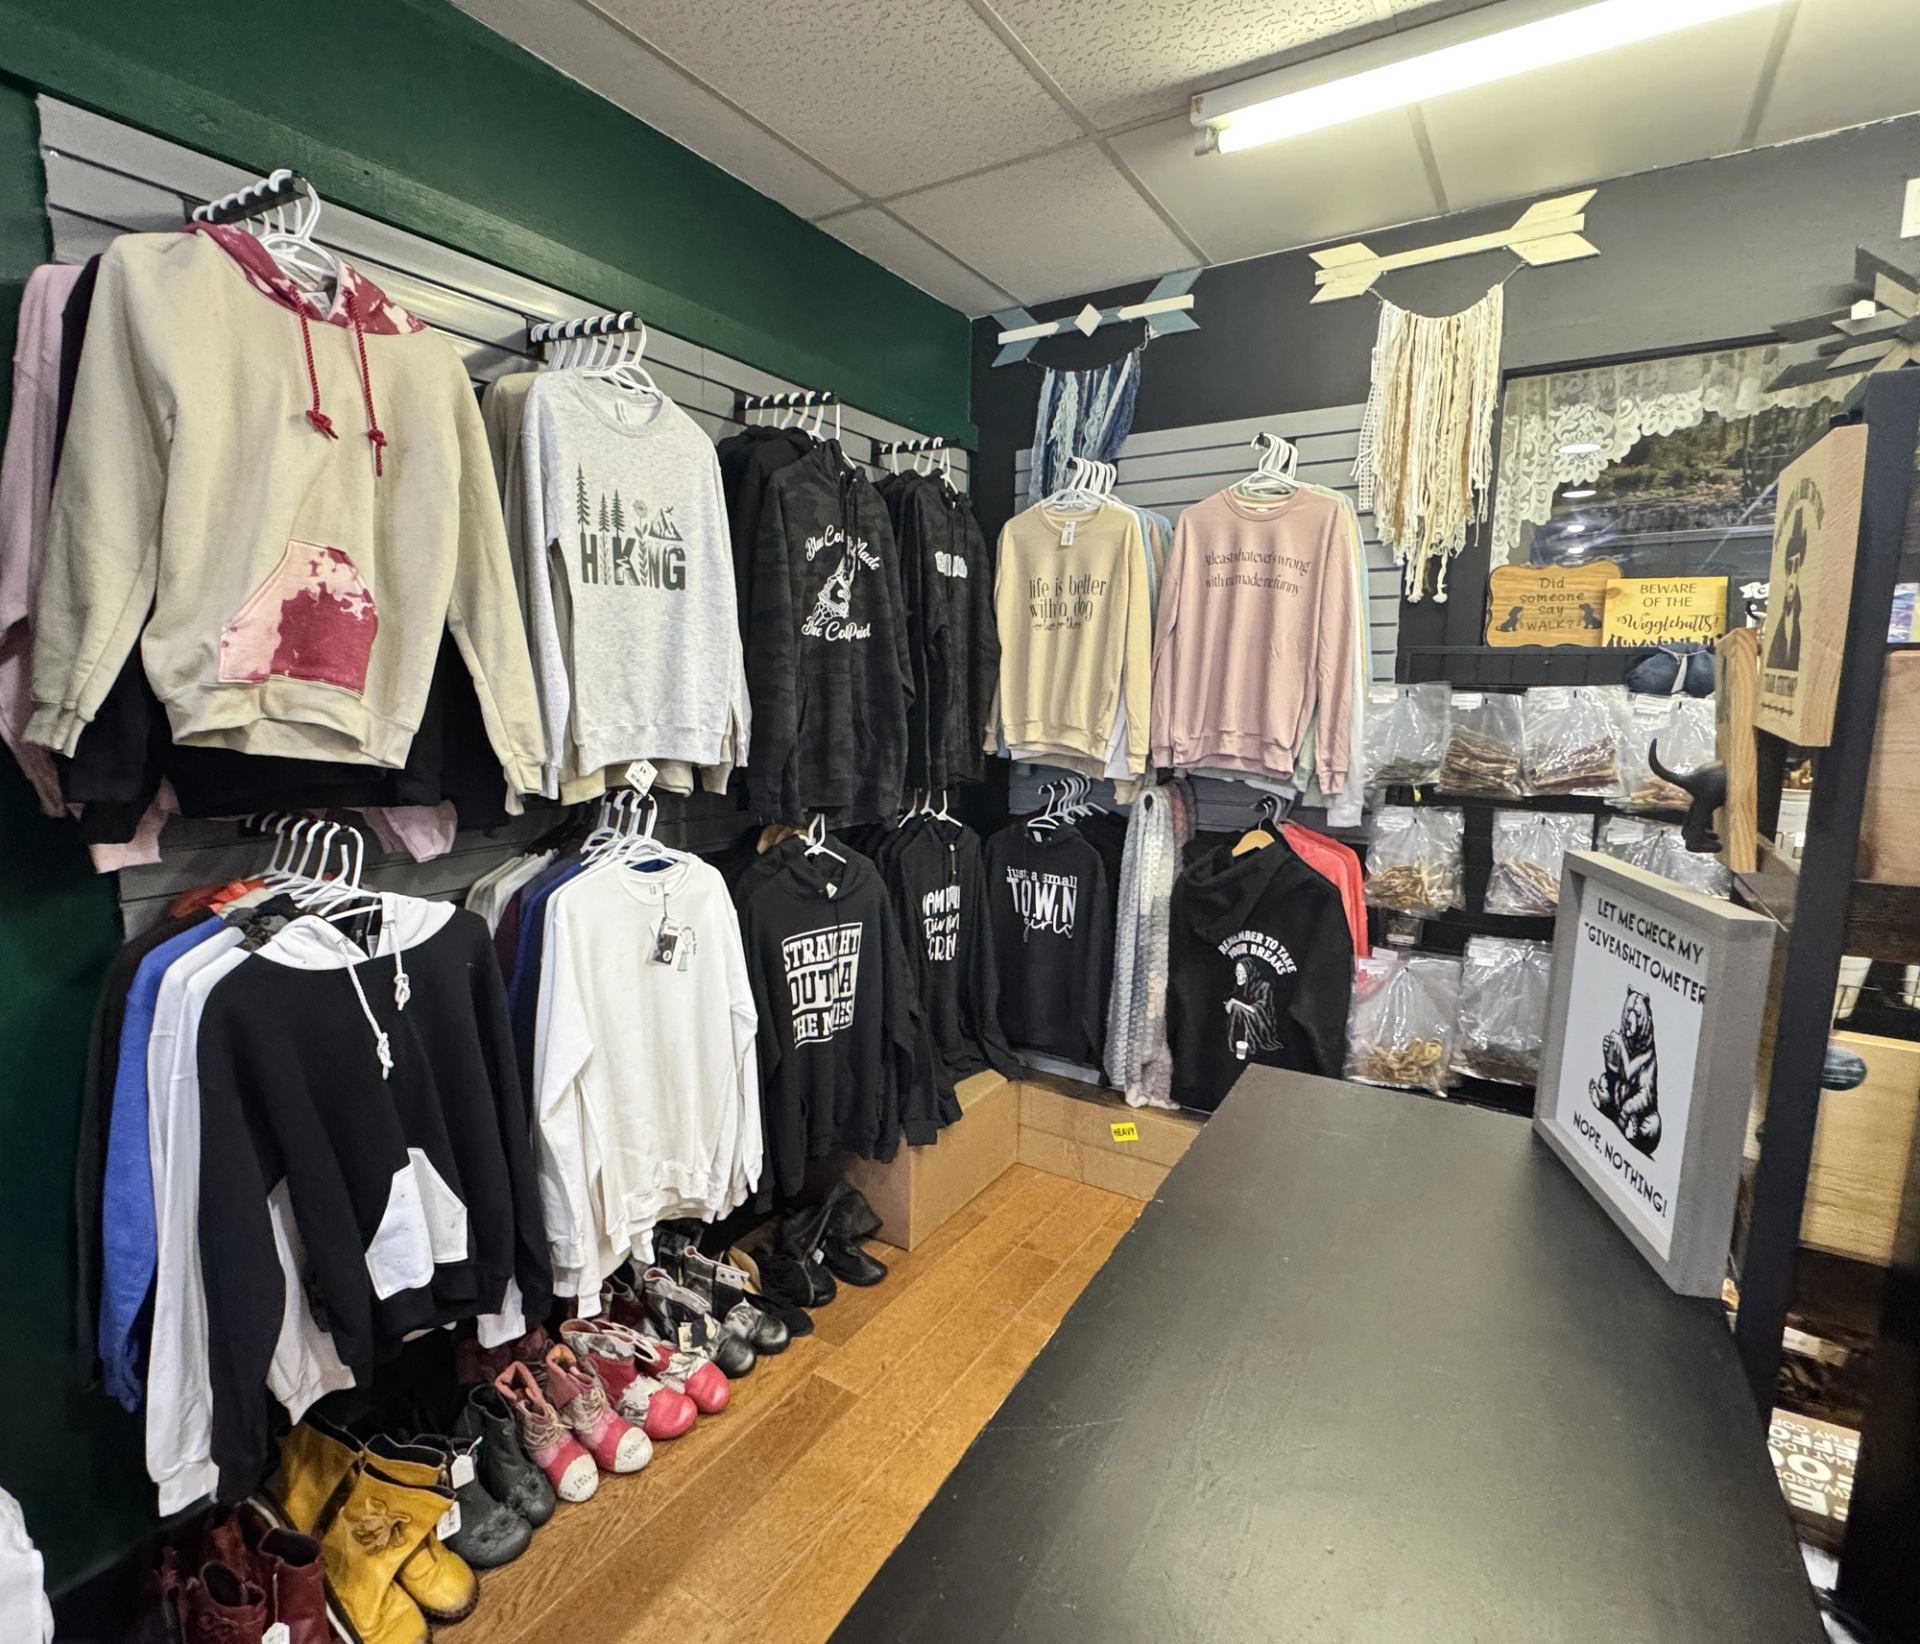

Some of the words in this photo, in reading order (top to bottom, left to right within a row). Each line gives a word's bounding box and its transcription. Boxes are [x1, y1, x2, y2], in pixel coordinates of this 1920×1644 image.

[1029, 577, 1049, 599] life
[1055, 576, 1063, 597] is
[1068, 573, 1107, 597] better
[1539, 576, 1565, 589] Did
[1640, 583, 1697, 594] BEWARE
[1029, 598, 1056, 619] with
[1060, 601, 1068, 617] a
[1074, 597, 1094, 621] dog
[1643, 597, 1661, 608] OF
[1665, 597, 1693, 608] THE
[1526, 620, 1575, 632] WALK?
[1006, 866, 1029, 880] just
[1031, 871, 1038, 881] a
[1042, 873, 1078, 889] small
[1006, 876, 1078, 924] TOWN
[1598, 898, 1617, 922] LET
[1617, 909, 1636, 932] ME
[1636, 917, 1676, 952] CHECK
[1677, 938, 1704, 964] MY
[783, 928, 860, 973] STRAIHT
[1218, 930, 1264, 955] REMEMBER
[1265, 936, 1279, 950] TO
[1276, 945, 1297, 974] TAKE
[1227, 943, 1248, 960] YOUR
[1250, 943, 1287, 975] BREAKS
[788, 960, 853, 1009] OUTA
[1113, 1127, 1135, 1137] HEAVY
[1604, 1141, 1668, 1218] NOTHING!
